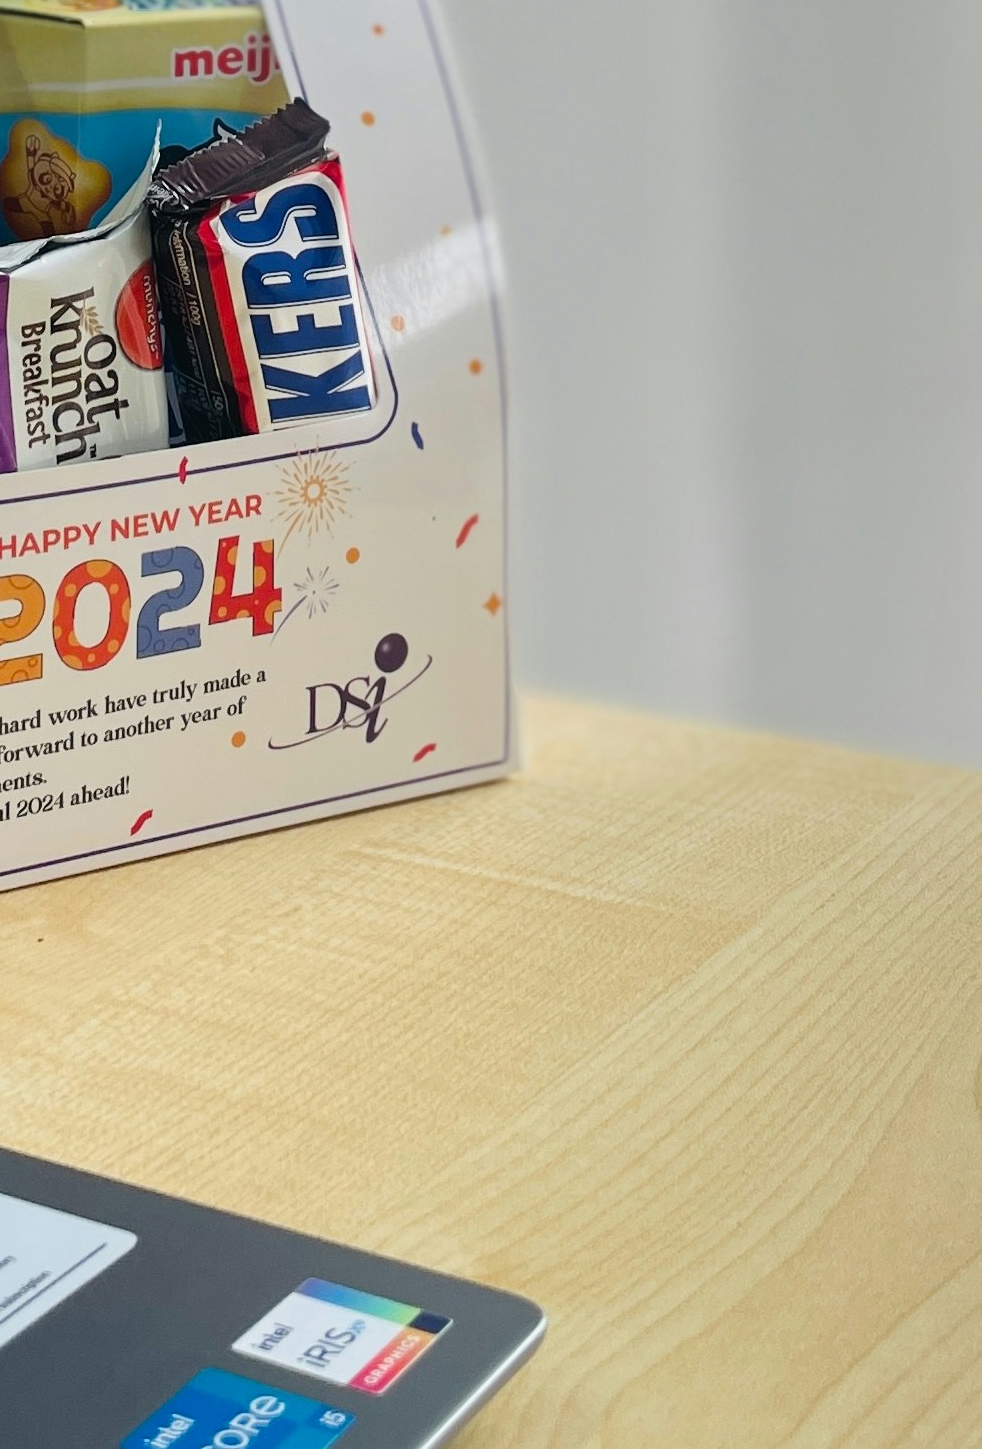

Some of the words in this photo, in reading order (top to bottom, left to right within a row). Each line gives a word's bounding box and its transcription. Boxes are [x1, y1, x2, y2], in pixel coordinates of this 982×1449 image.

[174, 34, 281, 82] meij
[219, 183, 371, 423] KERS
[21, 320, 51, 450] Breakfast
[110, 508, 180, 542] NEW
[188, 494, 263, 527] YEAR
[48, 699, 98, 726] work
[105, 693, 147, 715] have
[152, 680, 197, 704] truly
[203, 669, 251, 694] made
[256, 670, 266, 682] a
[81, 730, 98, 747] to
[103, 716, 175, 742] another
[180, 706, 222, 731] year
[227, 695, 247, 716] of
[16, 793, 64, 819] 2024
[70, 775, 130, 806] ahead!
[251, 1321, 294, 1351] intel
[364, 1334, 421, 1385] GRAPHICS
[144, 1413, 195, 1449] intel
[319, 1409, 346, 1428] i5
